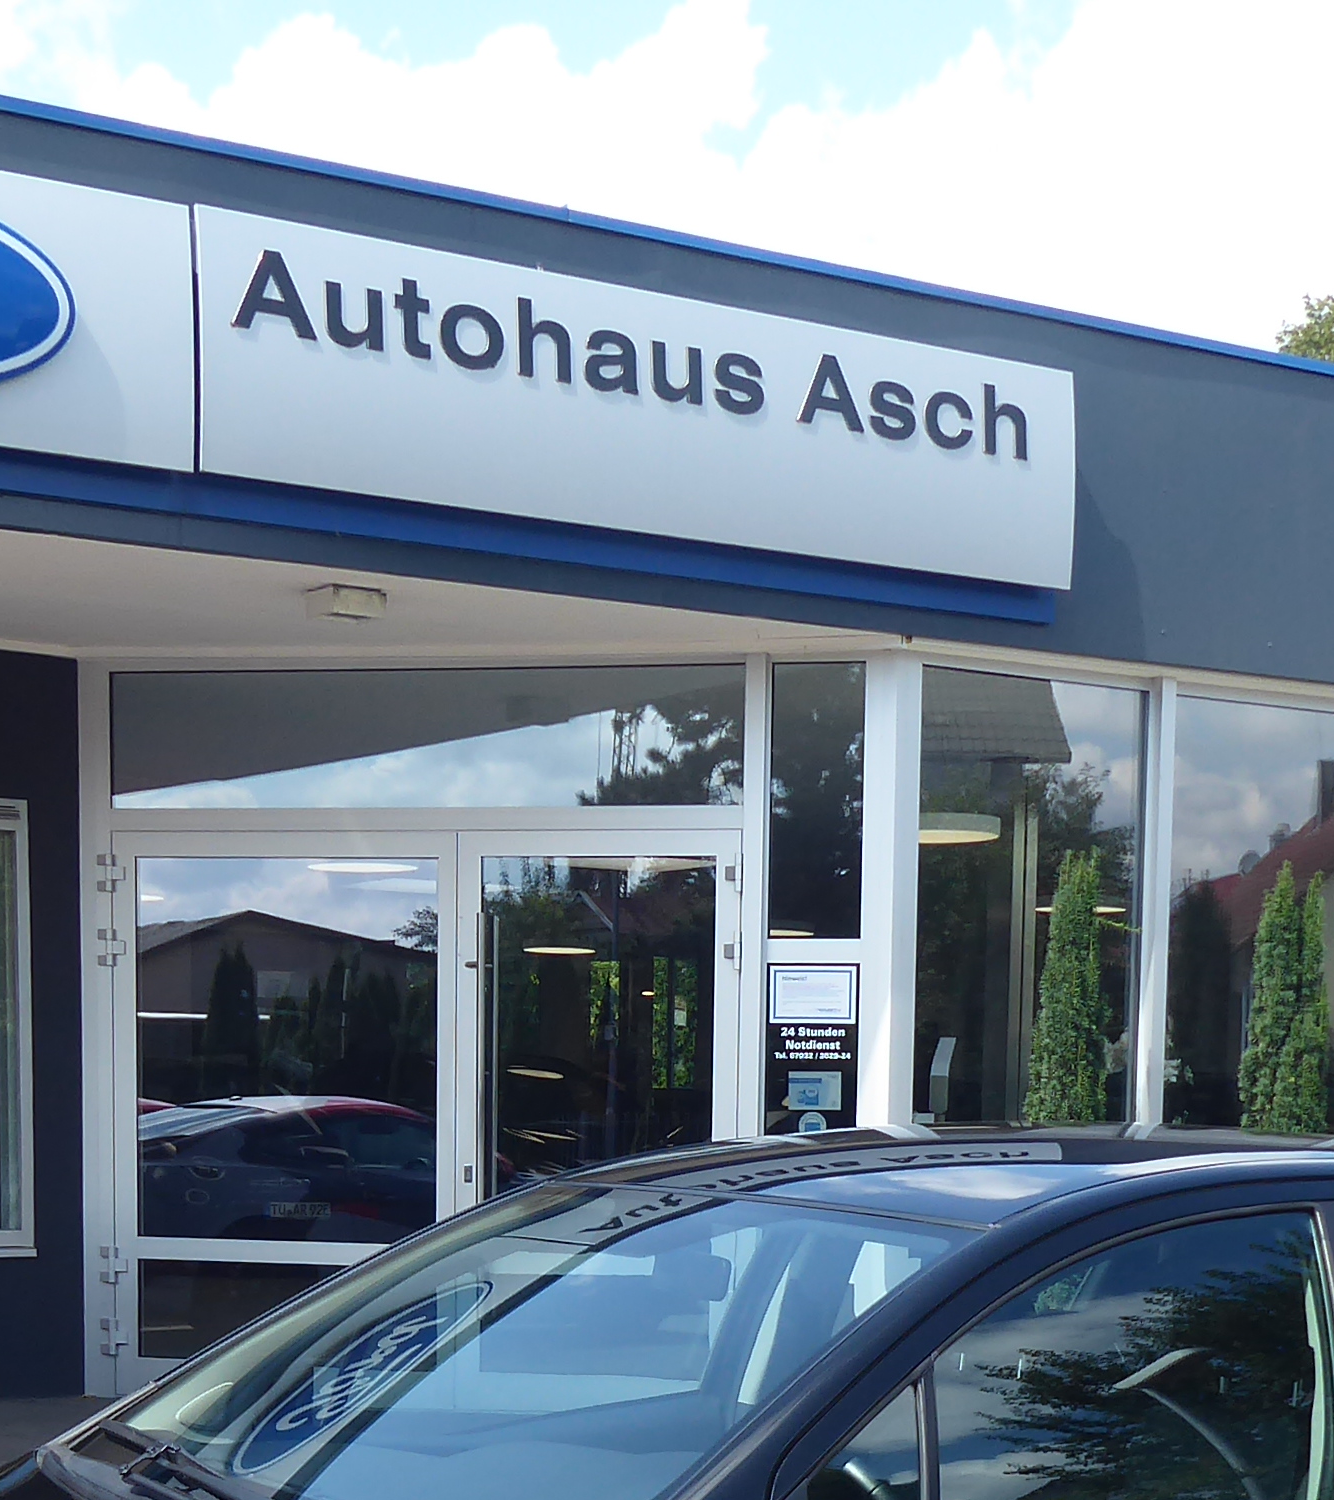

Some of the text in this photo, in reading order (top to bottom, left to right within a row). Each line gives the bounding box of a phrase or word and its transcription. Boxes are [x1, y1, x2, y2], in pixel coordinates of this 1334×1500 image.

[229, 248, 1031, 461] Autohaus Asch
[780, 1026, 846, 1037] 24 Stunden
[785, 1039, 841, 1051] Notdienst
